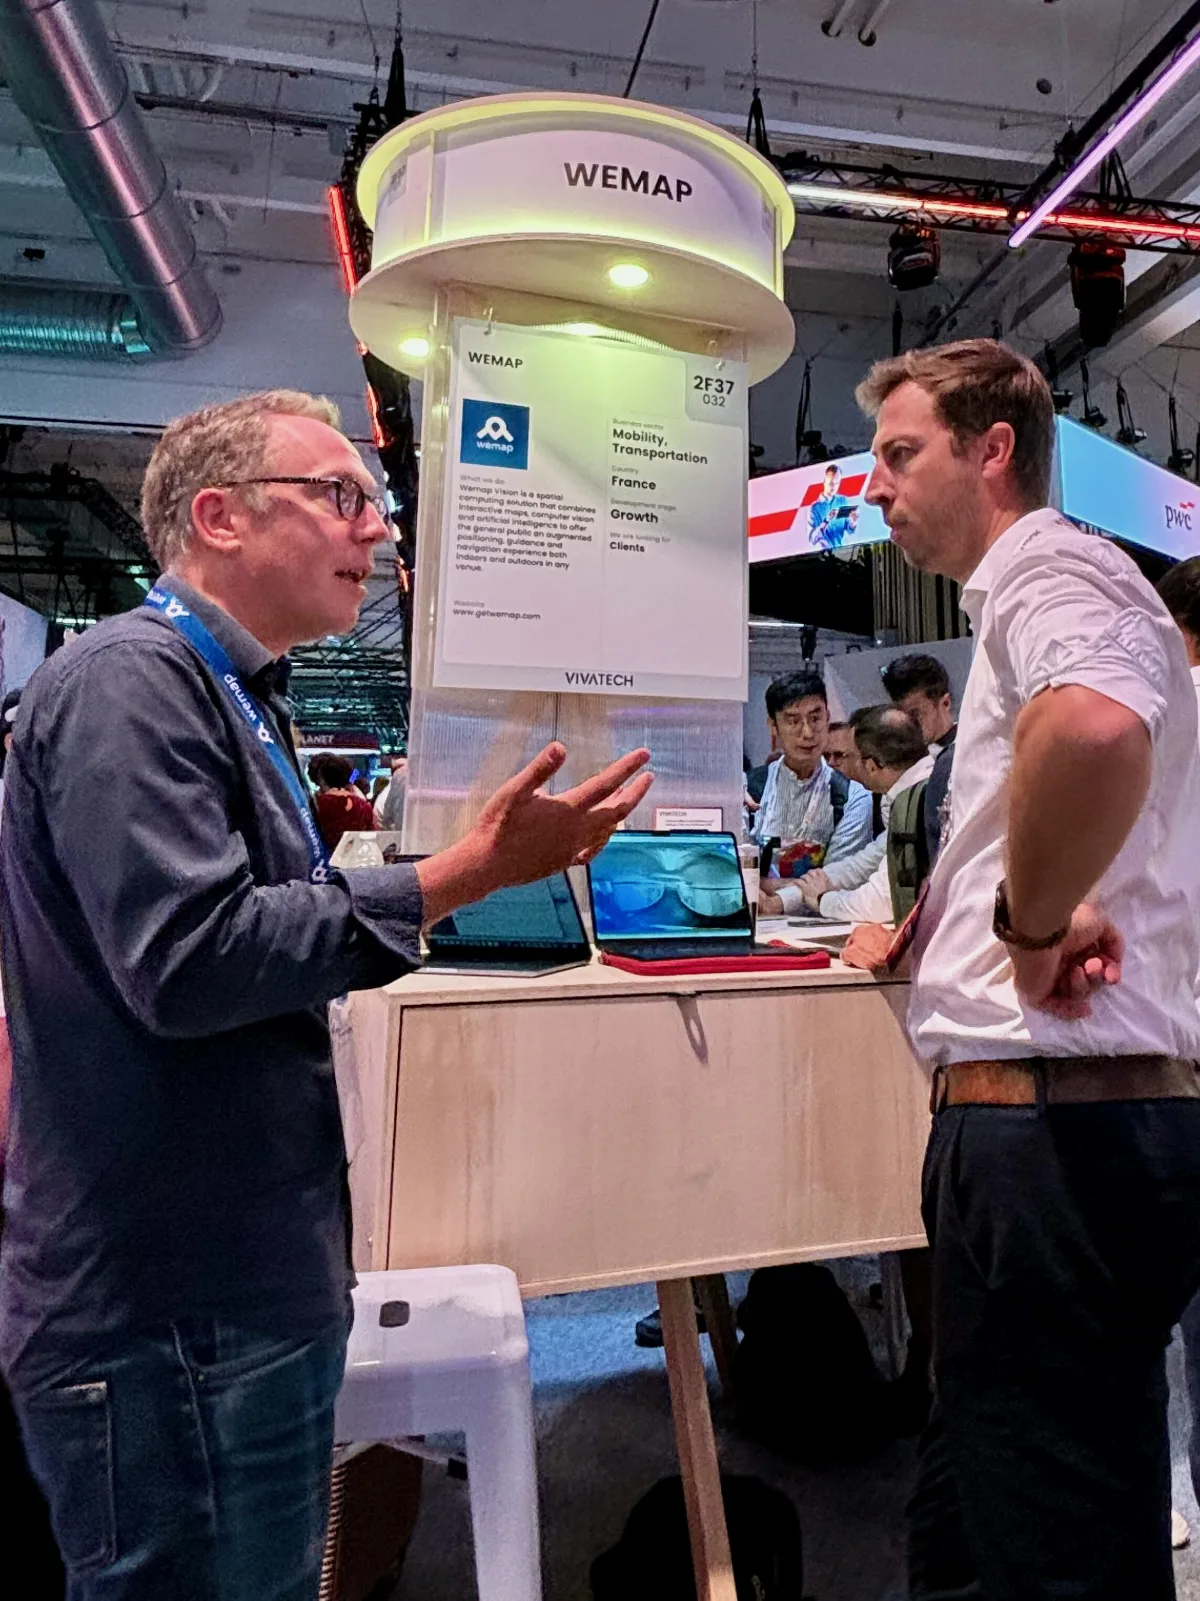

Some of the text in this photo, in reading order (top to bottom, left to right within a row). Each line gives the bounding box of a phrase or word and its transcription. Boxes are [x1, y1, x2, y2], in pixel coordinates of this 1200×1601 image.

[564, 162, 693, 203] WEMAP
[468, 351, 523, 369] WEMAP
[694, 375, 735, 395] 2F37
[703, 394, 726, 408] 032
[613, 428, 668, 447] Mobility,
[476, 441, 514, 454] wemap
[612, 443, 708, 464] Transportation
[612, 475, 656, 490] France
[460, 484, 492, 494] Wemap
[494, 487, 518, 496] Vision
[520, 489, 527, 497] is
[536, 491, 563, 501] spatial
[459, 494, 596, 514] computing solution that combines
[476, 515, 510, 525] artificial
[512, 519, 558, 529] intelligence
[559, 522, 567, 530] to
[569, 523, 587, 532] offer
[531, 511, 570, 521] computer
[572, 515, 595, 523] vision
[610, 509, 659, 523] Growth
[1165, 505, 1192, 531] pwc
[458, 523, 471, 531] the
[473, 525, 505, 534] general
[506, 527, 532, 537] public
[546, 531, 592, 542] augmented
[457, 543, 567, 559] navigation experience both
[507, 538, 545, 547] guidance
[547, 541, 563, 549] and
[610, 541, 645, 552] Clients
[456, 552, 487, 562] indoors
[507, 557, 543, 567] outdoors
[545, 560, 553, 568] in
[554, 563, 570, 571] any
[453, 608, 541, 620] www.getwemap.com
[565, 671, 634, 687] VIVATECH
[223, 673, 257, 722] wemap
